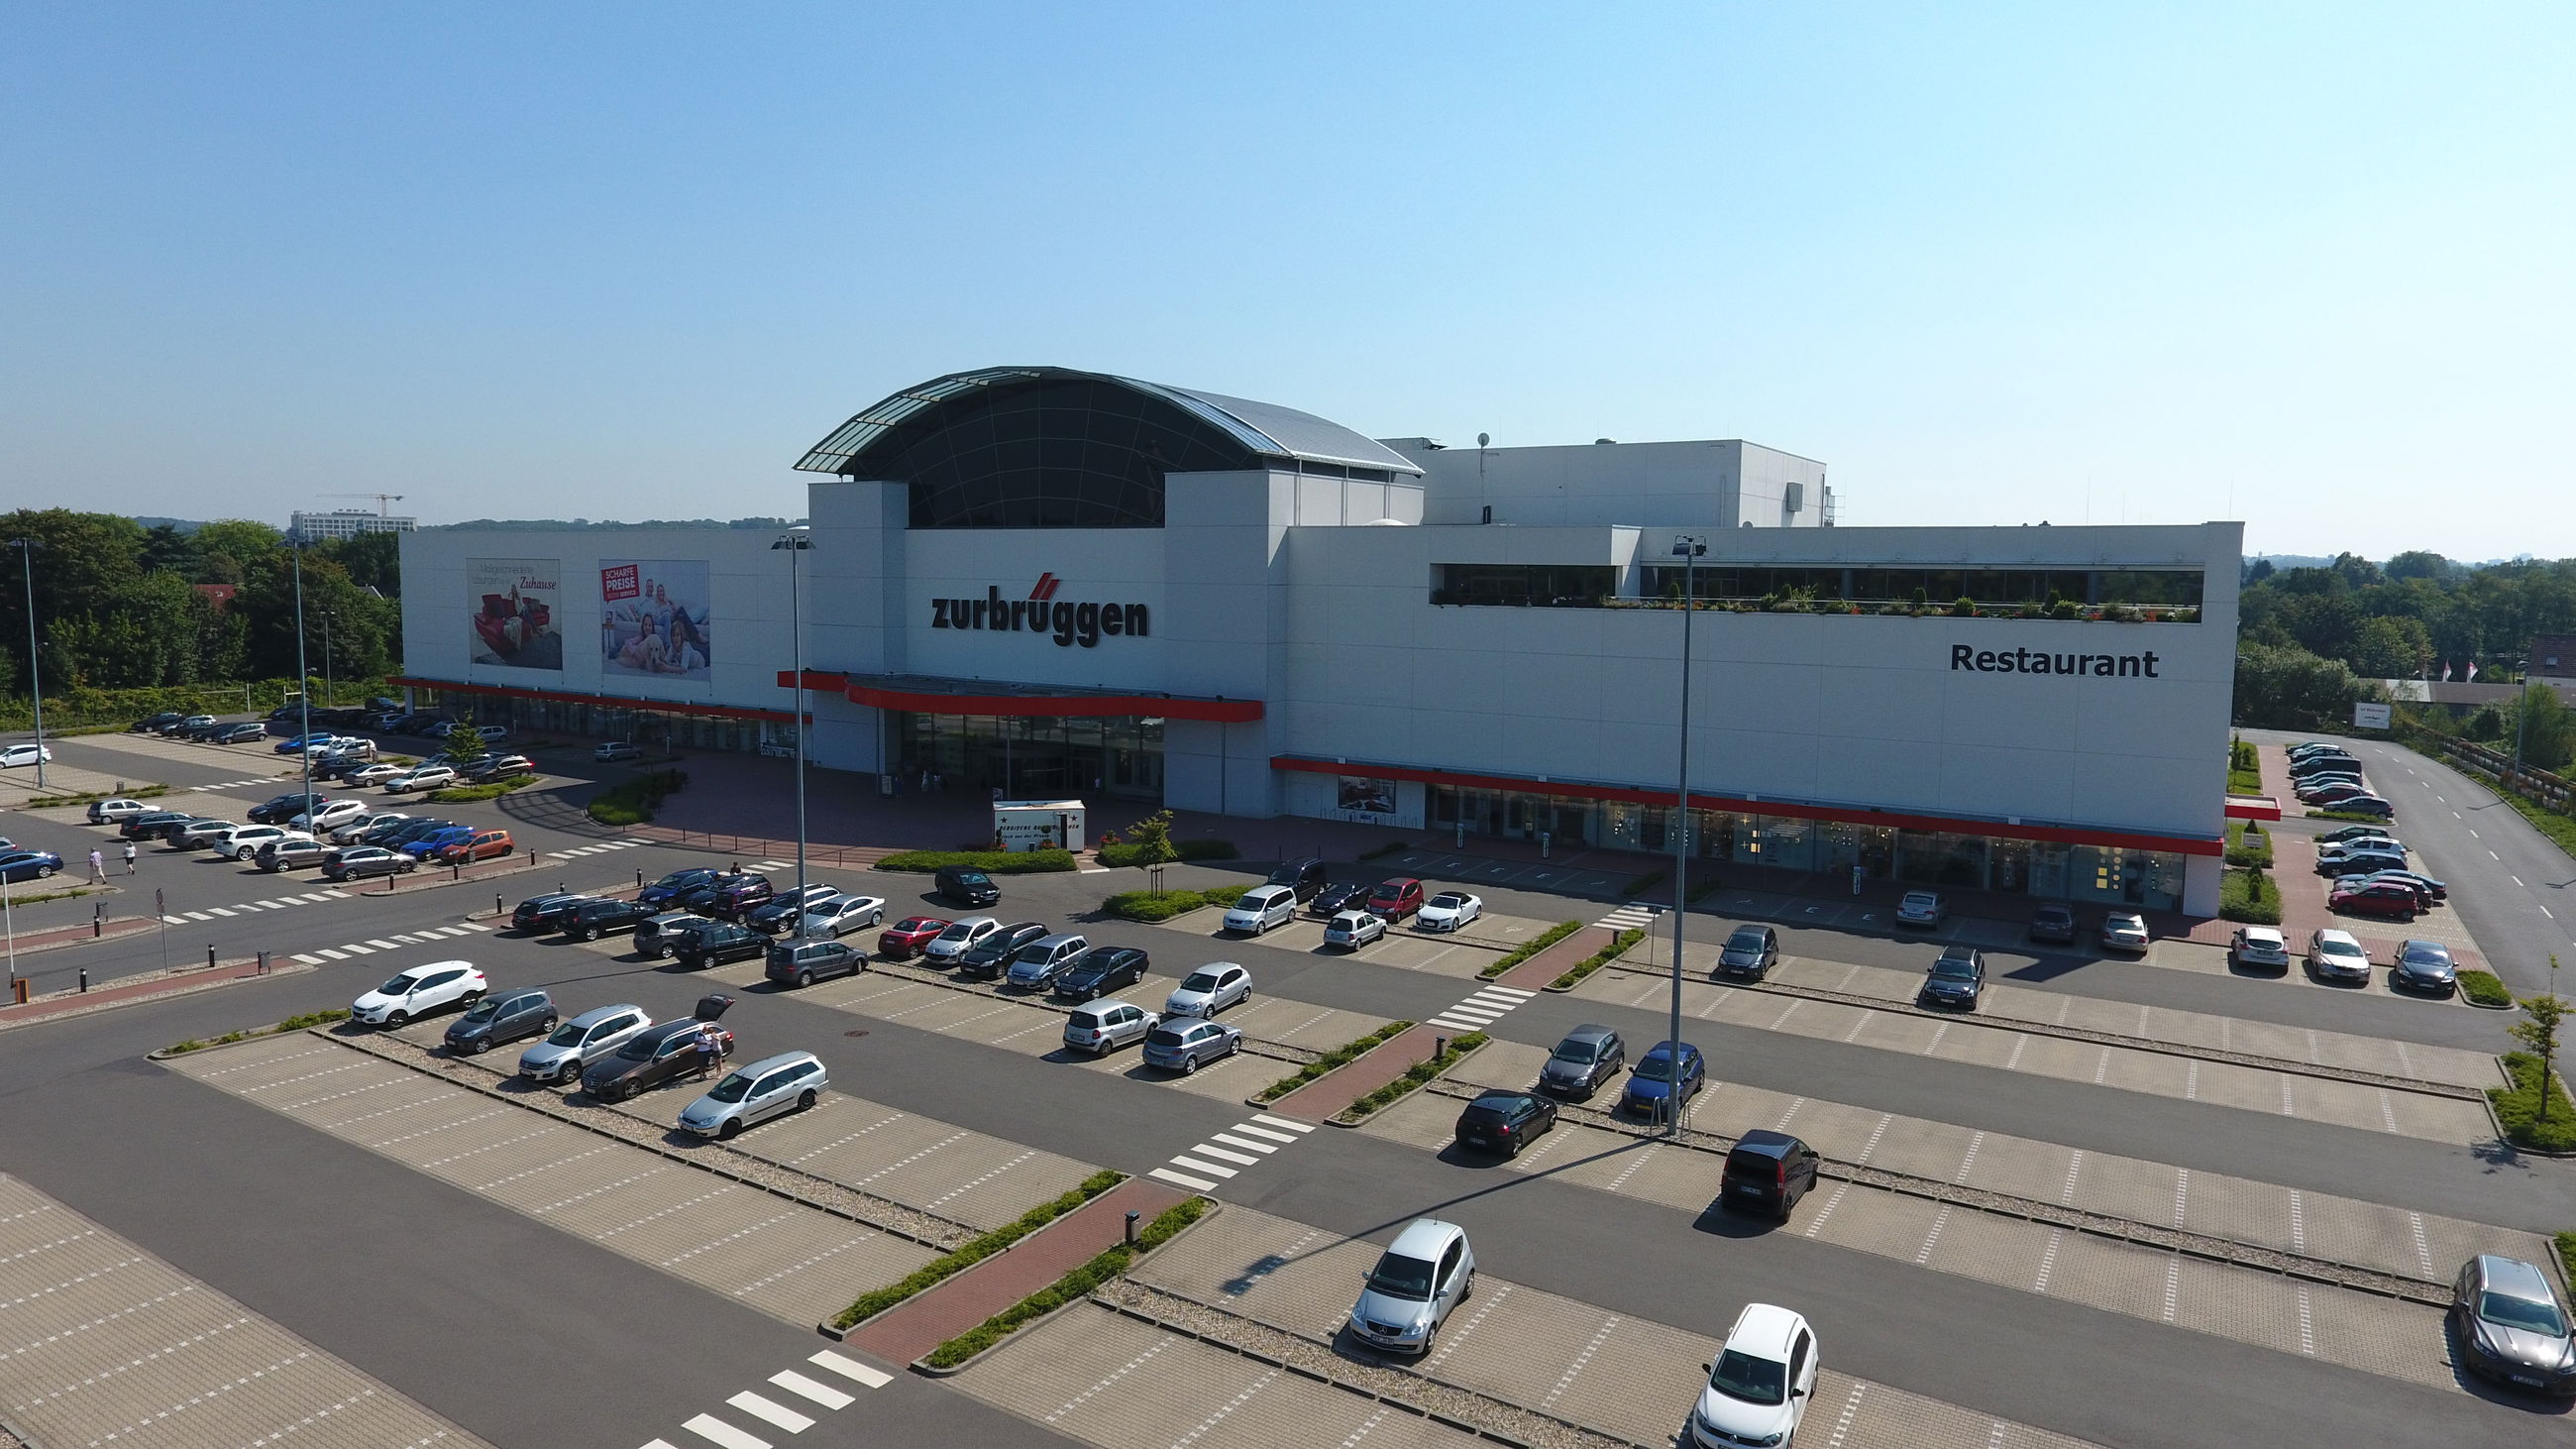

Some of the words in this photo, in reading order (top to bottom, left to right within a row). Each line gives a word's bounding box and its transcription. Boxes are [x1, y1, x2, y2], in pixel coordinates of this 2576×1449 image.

[605, 566, 634, 580] SCHARFE
[519, 576, 557, 590] Zuhause
[606, 577, 636, 592] PREISE
[931, 572, 1148, 648] zurbrüggen
[1951, 644, 2160, 678] Restaurant
